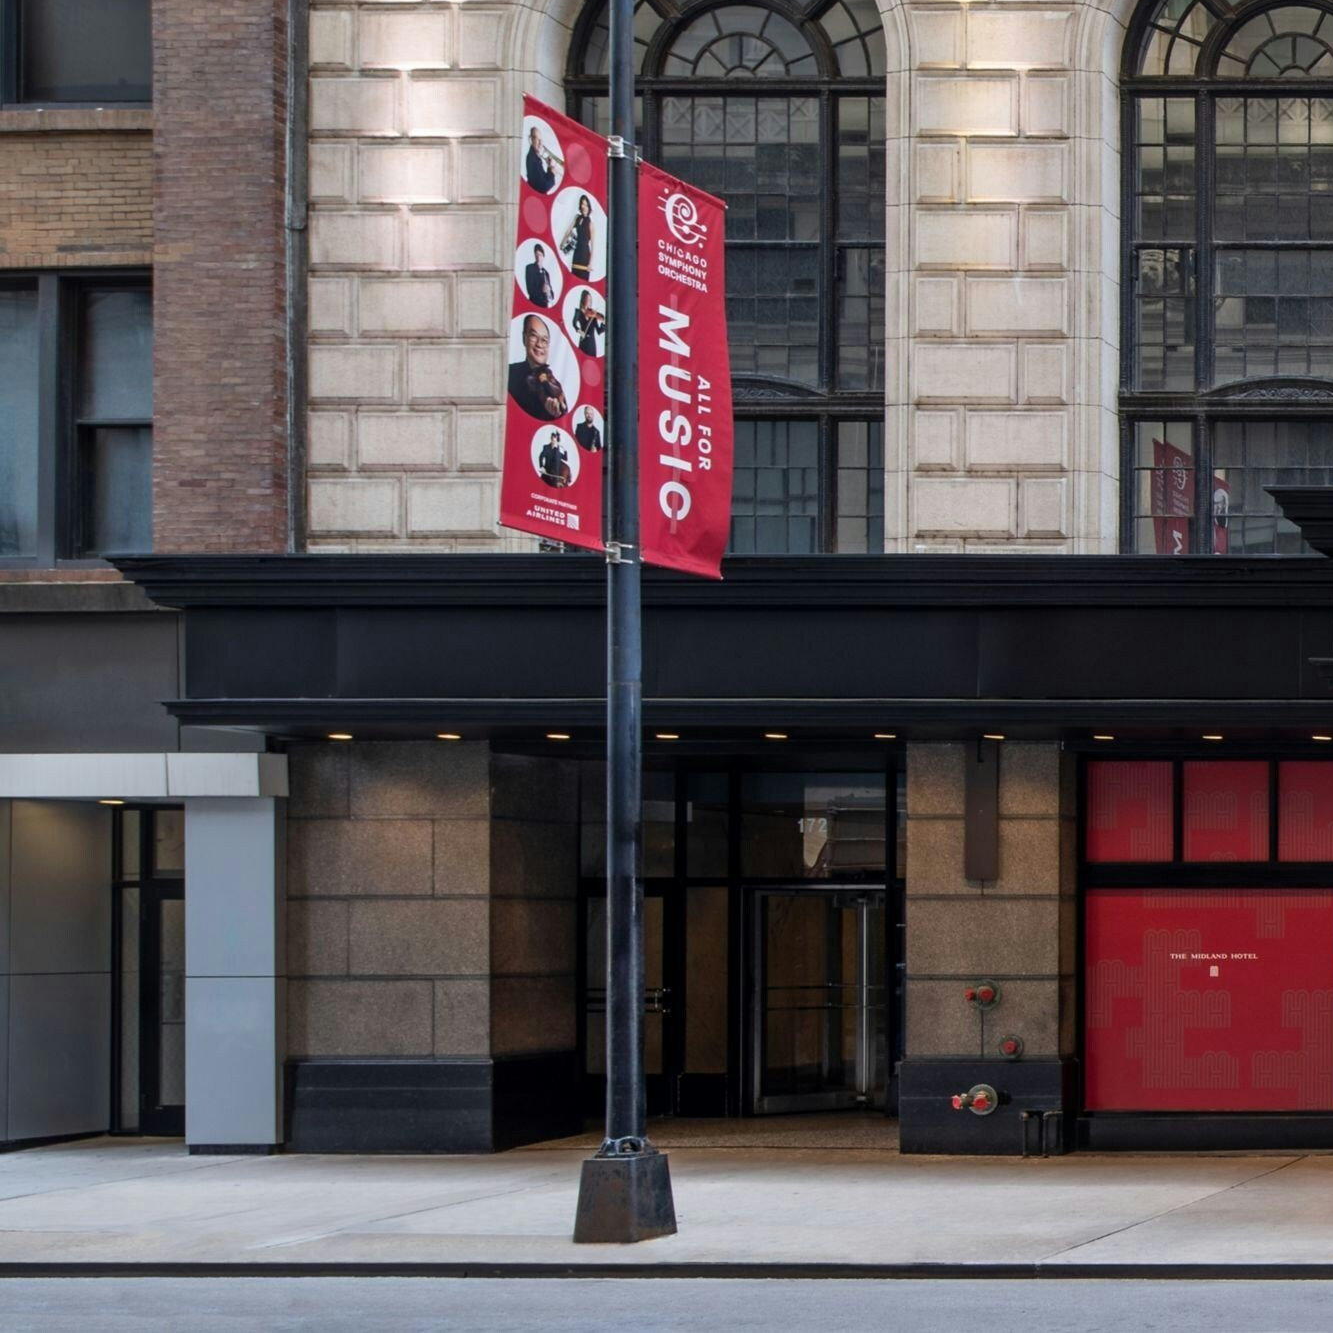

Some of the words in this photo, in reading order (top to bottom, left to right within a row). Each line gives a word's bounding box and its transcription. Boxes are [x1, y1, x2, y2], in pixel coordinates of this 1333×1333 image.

[658, 239, 707, 268] CHICAGO
[658, 252, 707, 280] SYMPHONY
[658, 265, 708, 293] ORCHESTRA
[697, 375, 712, 415] ALL
[658, 304, 692, 521] MUSIC
[698, 424, 712, 471] FOR
[526, 510, 565, 525] AIRLINES
[534, 505, 565, 518] UNITED
[797, 817, 828, 834] 172
